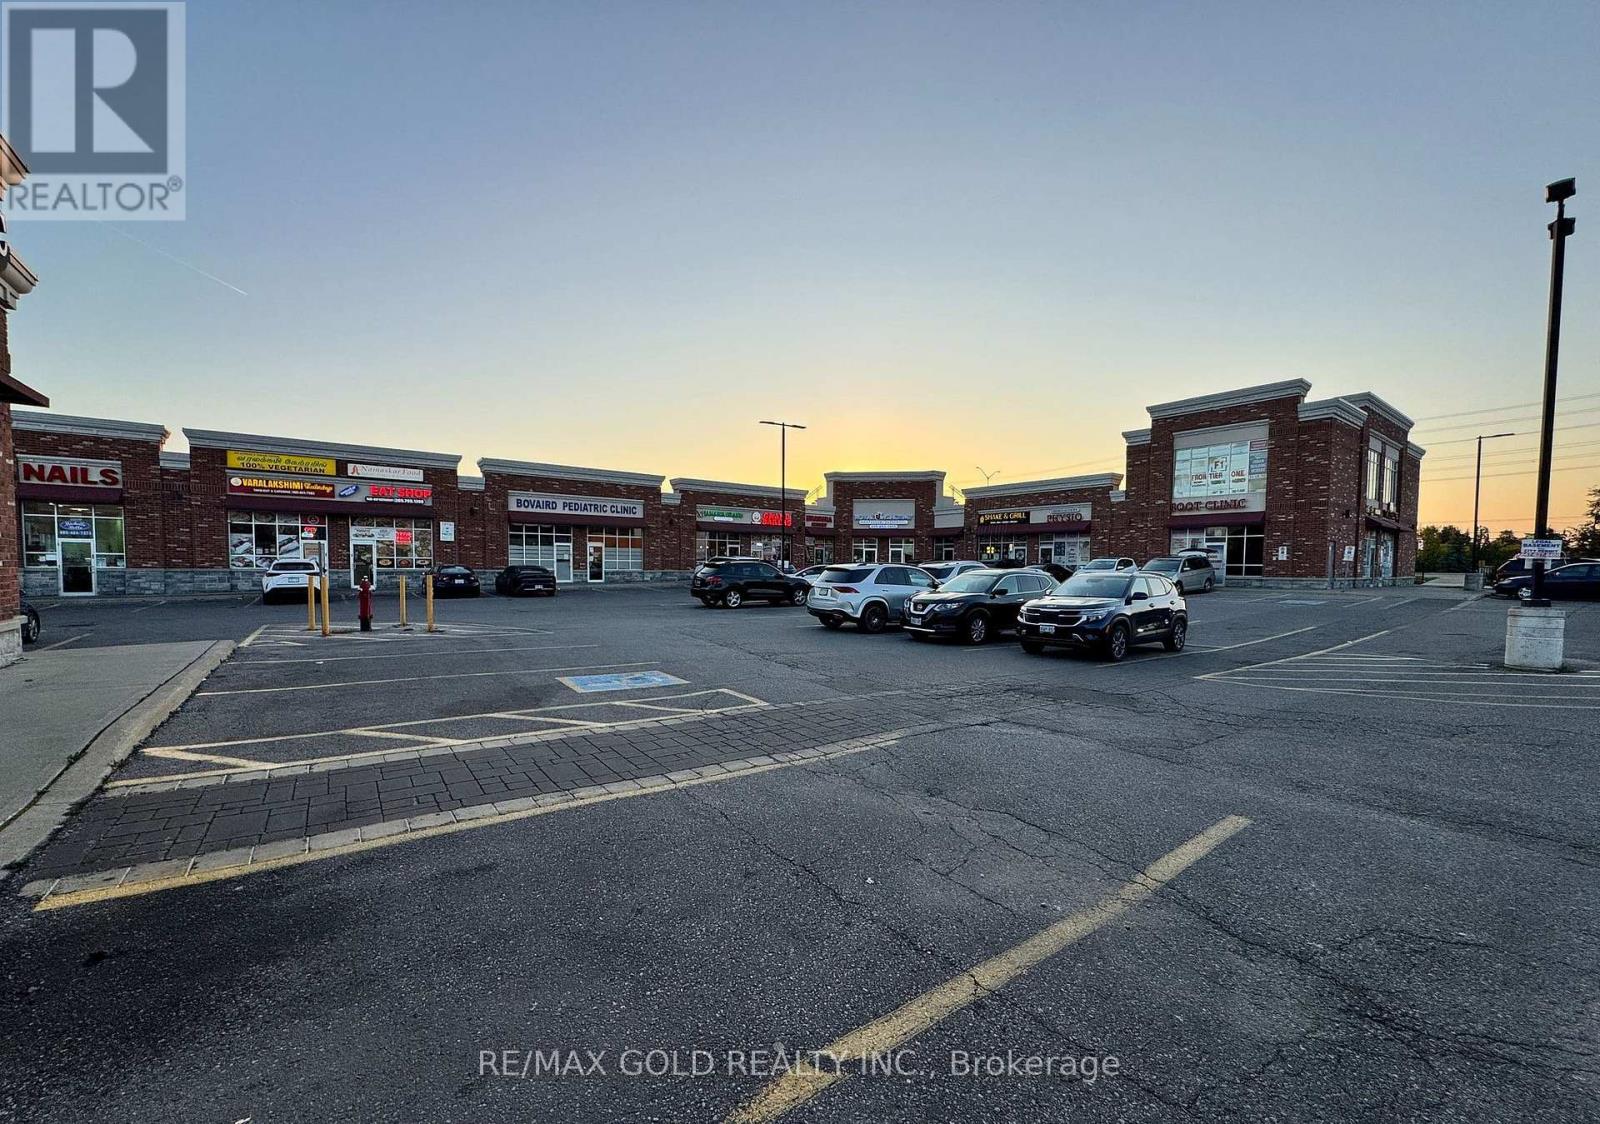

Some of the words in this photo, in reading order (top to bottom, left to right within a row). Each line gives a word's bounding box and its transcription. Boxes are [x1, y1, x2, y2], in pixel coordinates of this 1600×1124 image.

[23, 463, 120, 486] NAILS
[268, 464, 325, 474] VEGETARIAN
[361, 465, 400, 474] Namaskar
[402, 468, 421, 476] Food
[242, 478, 304, 490] VARALAKSHIMI
[370, 484, 395, 497] EAT
[397, 487, 432, 499] SHOP
[516, 498, 557, 510] BOVAIRD
[562, 501, 608, 513] PEDIATRIC
[610, 505, 637, 515] CLINIC
[1205, 498, 1246, 510] CLINIC
